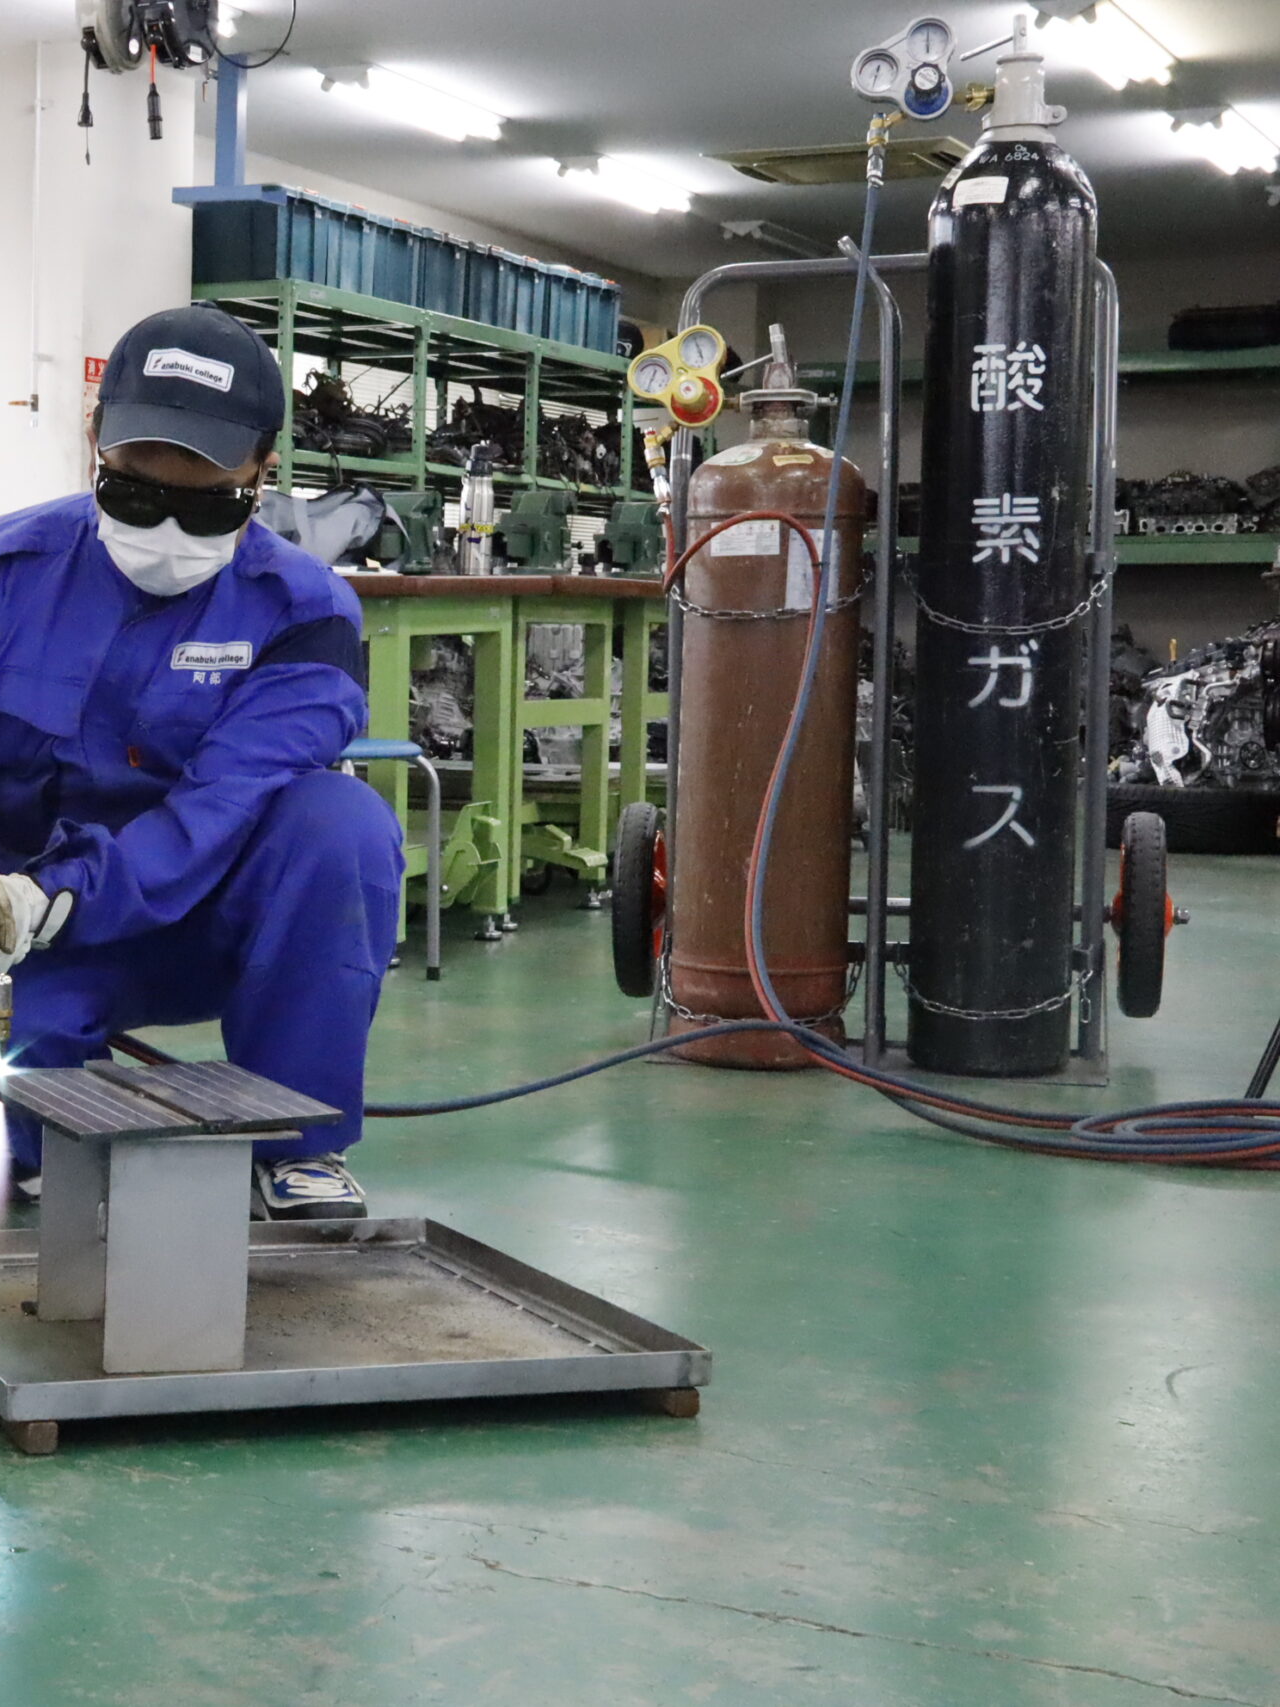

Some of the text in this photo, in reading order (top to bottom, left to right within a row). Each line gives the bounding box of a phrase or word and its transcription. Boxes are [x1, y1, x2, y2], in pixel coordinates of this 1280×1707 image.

[1005, 152, 1040, 161] 6824
[161, 361, 224, 382] anabuki college
[963, 340, 1046, 848] 酸素ガス
[185, 655, 217, 664] anabuki
